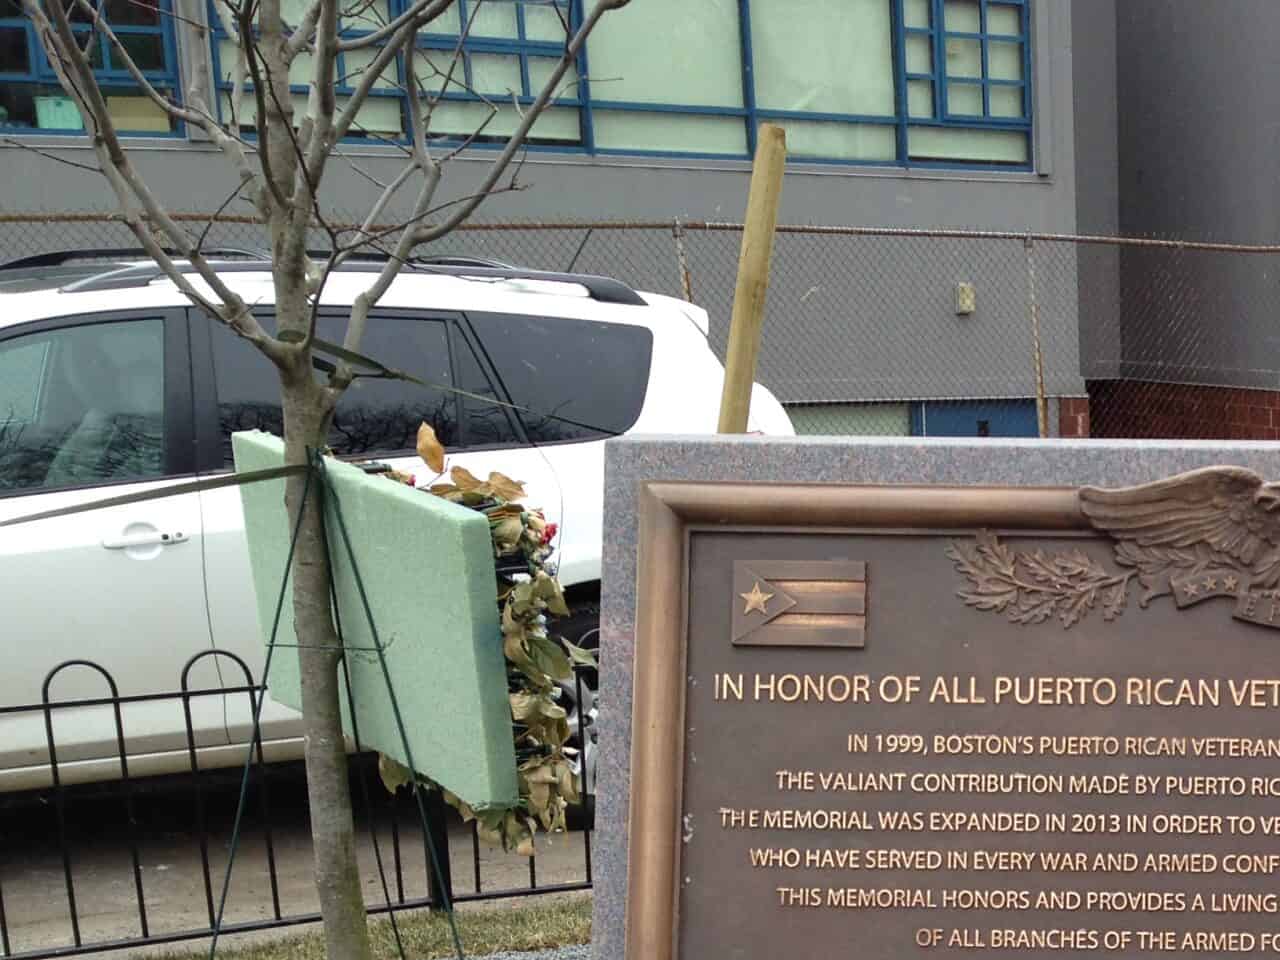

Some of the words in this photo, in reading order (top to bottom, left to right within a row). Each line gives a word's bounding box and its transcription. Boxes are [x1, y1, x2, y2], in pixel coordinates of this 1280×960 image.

[714, 672, 744, 699] IN
[754, 672, 874, 701] HONOR
[878, 674, 921, 703] OF
[929, 675, 986, 704] ALL
[994, 676, 1117, 705] PUERTO
[1125, 677, 1220, 707] RICAN
[847, 733, 868, 753] IN
[874, 733, 929, 756] 1999,
[933, 733, 1034, 755] BOSTON'S
[1039, 735, 1120, 755] PUERTO
[1124, 735, 1187, 756] RICAN
[775, 769, 815, 791] THE
[818, 771, 908, 792] VALIANT
[910, 771, 1063, 793] CONTRIBUTION
[1068, 772, 1130, 794] MADE
[1134, 774, 1161, 795] BY
[1165, 775, 1246, 796] PUERTO
[718, 806, 760, 828] THE
[762, 809, 874, 830] MEMORIAL
[877, 810, 925, 831] WAS
[929, 811, 1041, 832] EXPANDED
[1045, 812, 1066, 833] IN
[1071, 813, 1121, 833] 2013
[1126, 813, 1148, 833] IN
[1151, 813, 1223, 834] ORDER
[1225, 815, 1256, 835] TO
[749, 847, 801, 868] WHO
[805, 847, 861, 869] HAVE
[864, 848, 943, 870] SERVED
[947, 850, 968, 870] IN
[973, 849, 1036, 871] EVERY
[1039, 851, 1088, 872] WAR
[1091, 852, 1139, 872] AND
[1143, 852, 1218, 873] ARMED
[775, 887, 822, 907] THIS
[826, 887, 938, 908] MEMORIAL
[941, 887, 1031, 910] HONORS
[1034, 890, 1081, 910] AND
[1086, 890, 1186, 911] PROVIDES
[1190, 892, 1206, 912] A
[1211, 892, 1278, 913] LIVING
[915, 927, 944, 947] OF
[947, 927, 986, 948] ALL
[990, 927, 1099, 950] BRANCHES
[1103, 930, 1133, 950] OF
[1135, 930, 1177, 950] THE
[1180, 931, 1256, 952] ARMED
